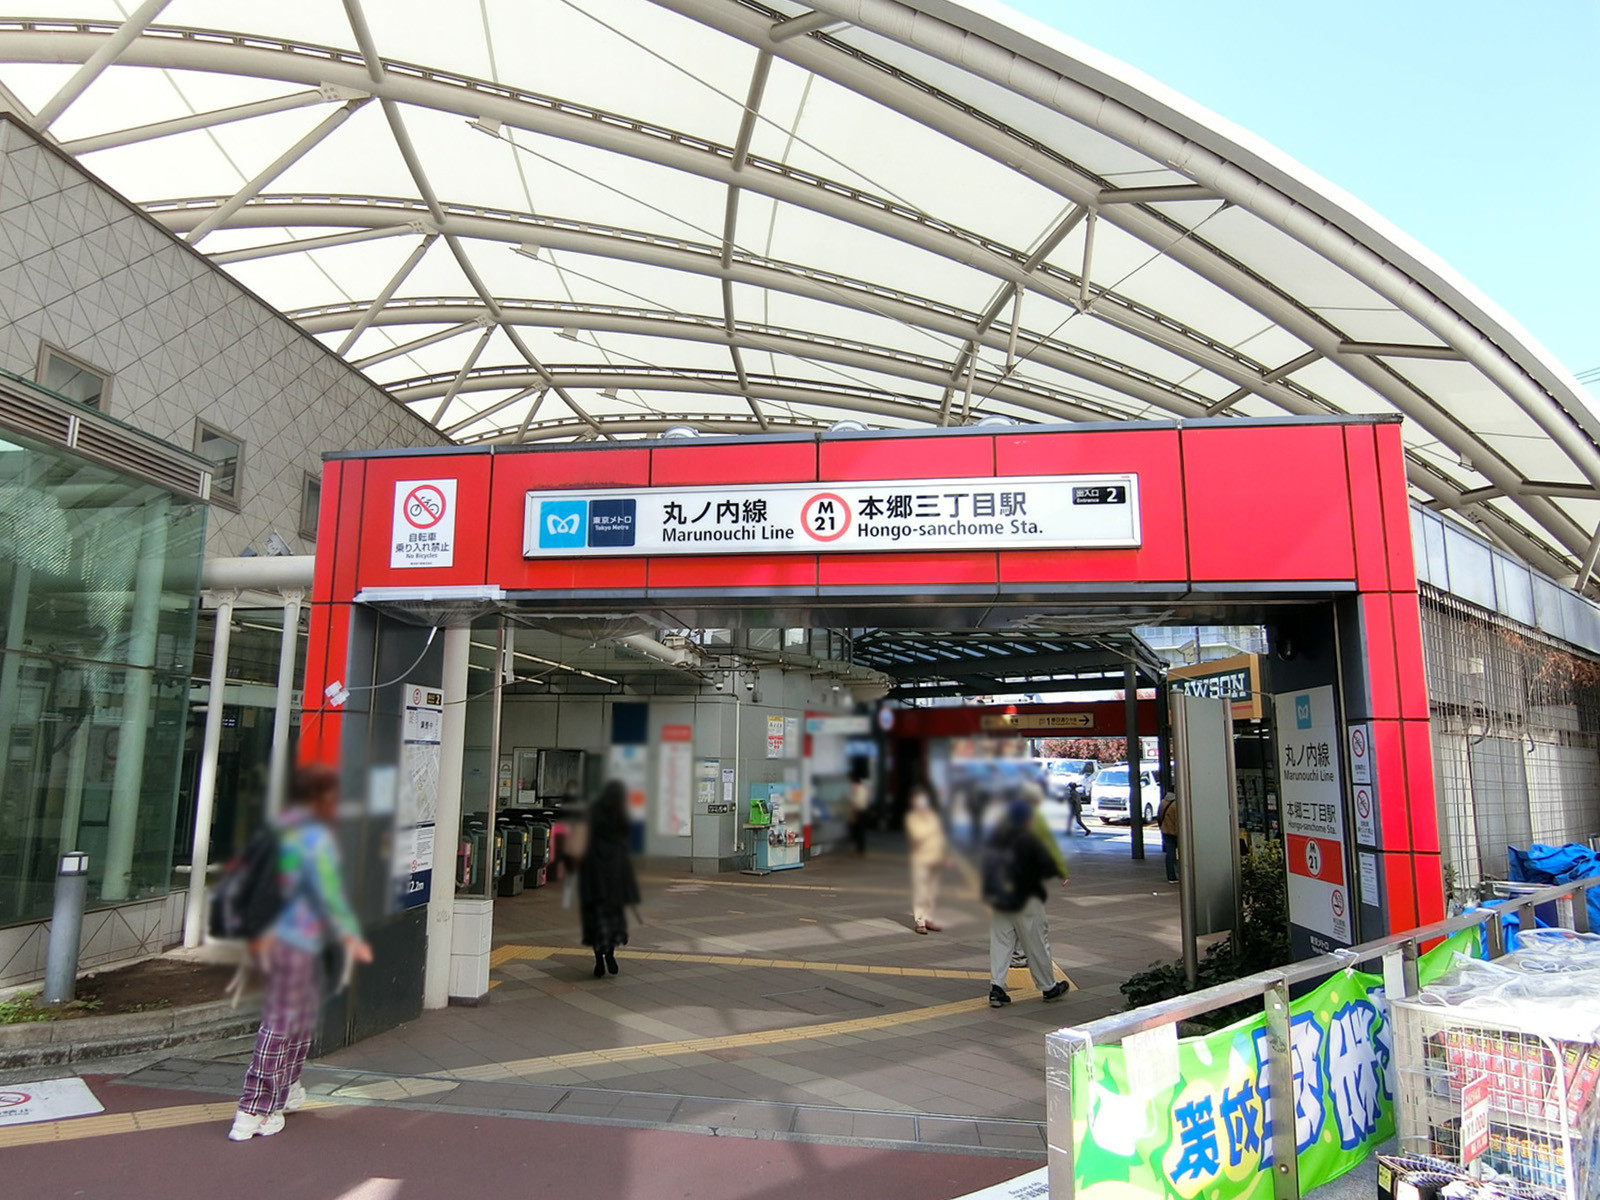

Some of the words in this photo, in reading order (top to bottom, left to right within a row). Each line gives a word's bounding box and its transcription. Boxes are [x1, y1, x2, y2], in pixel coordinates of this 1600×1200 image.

[1106, 487, 1118, 502] 2
[663, 498, 767, 525] 丸ノ内線
[818, 501, 834, 514] M
[858, 491, 1027, 520] 本郷三丁目駅
[593, 516, 632, 524] 東京メトロ
[814, 516, 835, 531] 21
[409, 532, 437, 543] 自転車
[662, 525, 756, 542] Marunouchi
[762, 525, 795, 540] Line
[858, 520, 1004, 541] Hongo-sanchome
[1010, 519, 1043, 534] Sta.
[395, 542, 450, 552] 乗り入れ禁止
[1285, 742, 1330, 768] 丸ノ内線
[1284, 769, 1319, 782] Marunouchi
[1320, 770, 1334, 782] Line
[1287, 801, 1336, 823] 本郷三丁目駅
[1308, 855, 1318, 870] 21
